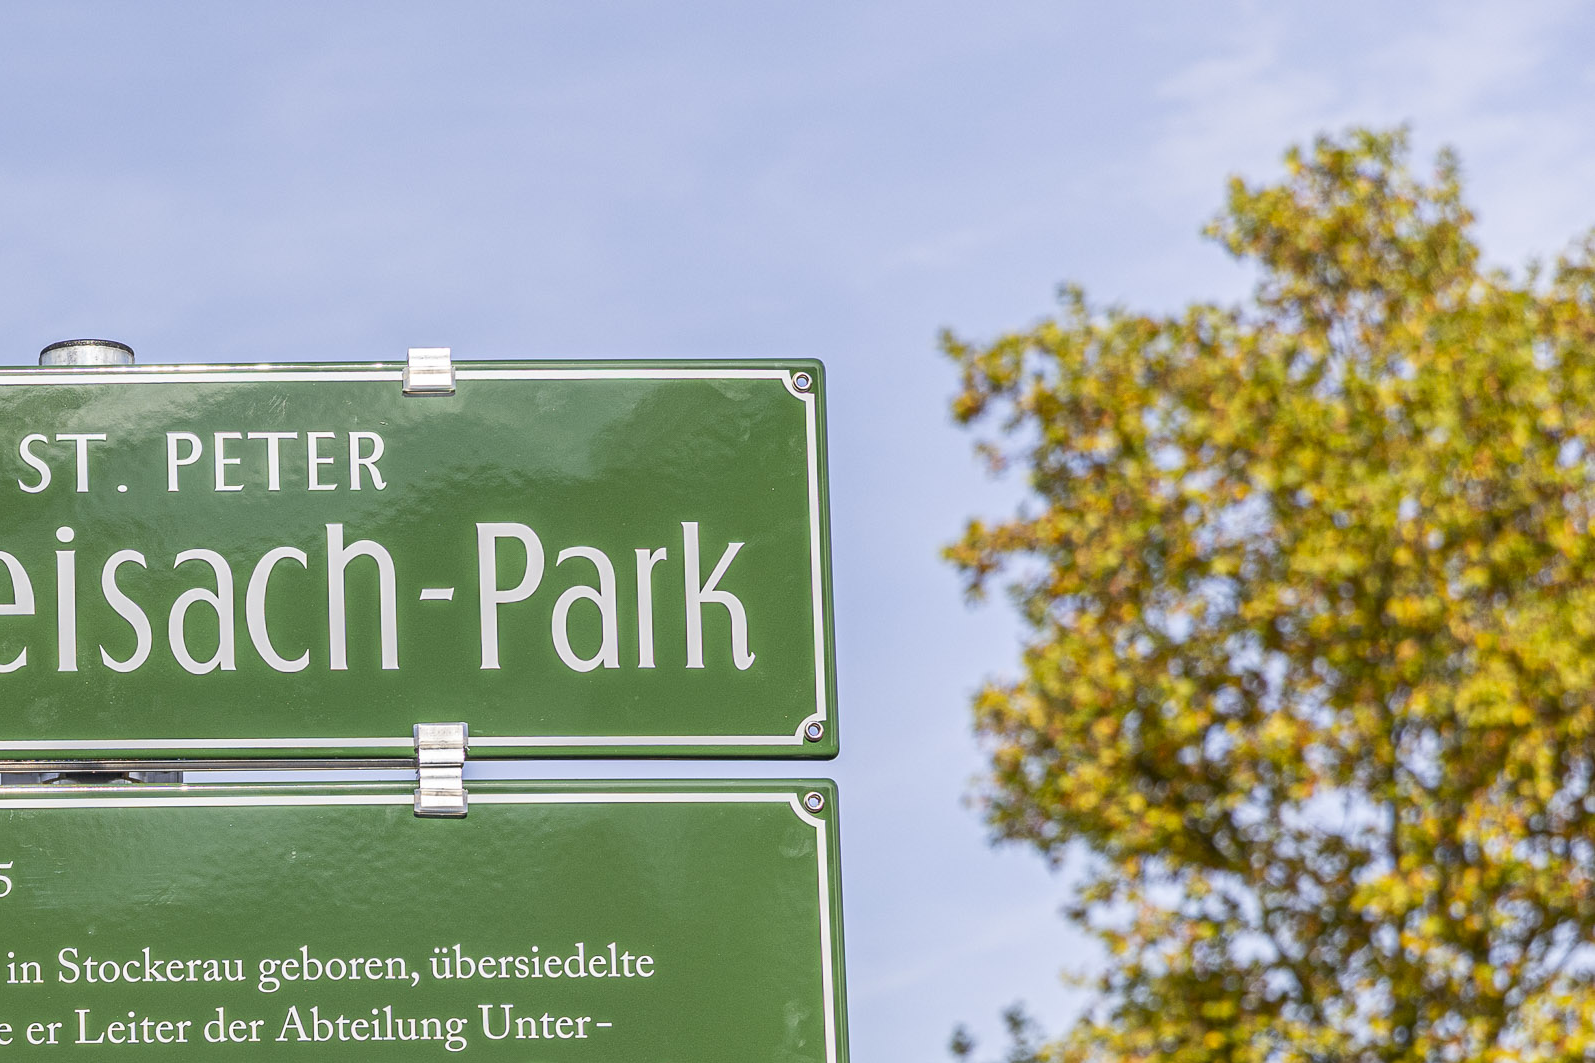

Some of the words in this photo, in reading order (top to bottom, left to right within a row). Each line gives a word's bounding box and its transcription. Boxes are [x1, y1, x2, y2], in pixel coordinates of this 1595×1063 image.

[17, 431, 128, 494] ST.
[165, 430, 388, 492] PETER
[6, 951, 44, 984] in
[57, 946, 247, 984] Stockerau
[257, 944, 420, 993] geboren,
[428, 941, 655, 980] übersiedelte
[26, 1022, 63, 1045] er
[74, 1008, 192, 1044] Leiter
[203, 1006, 265, 1043] der
[274, 1004, 468, 1052] Abteilung
[477, 1003, 613, 1040] Unter-
